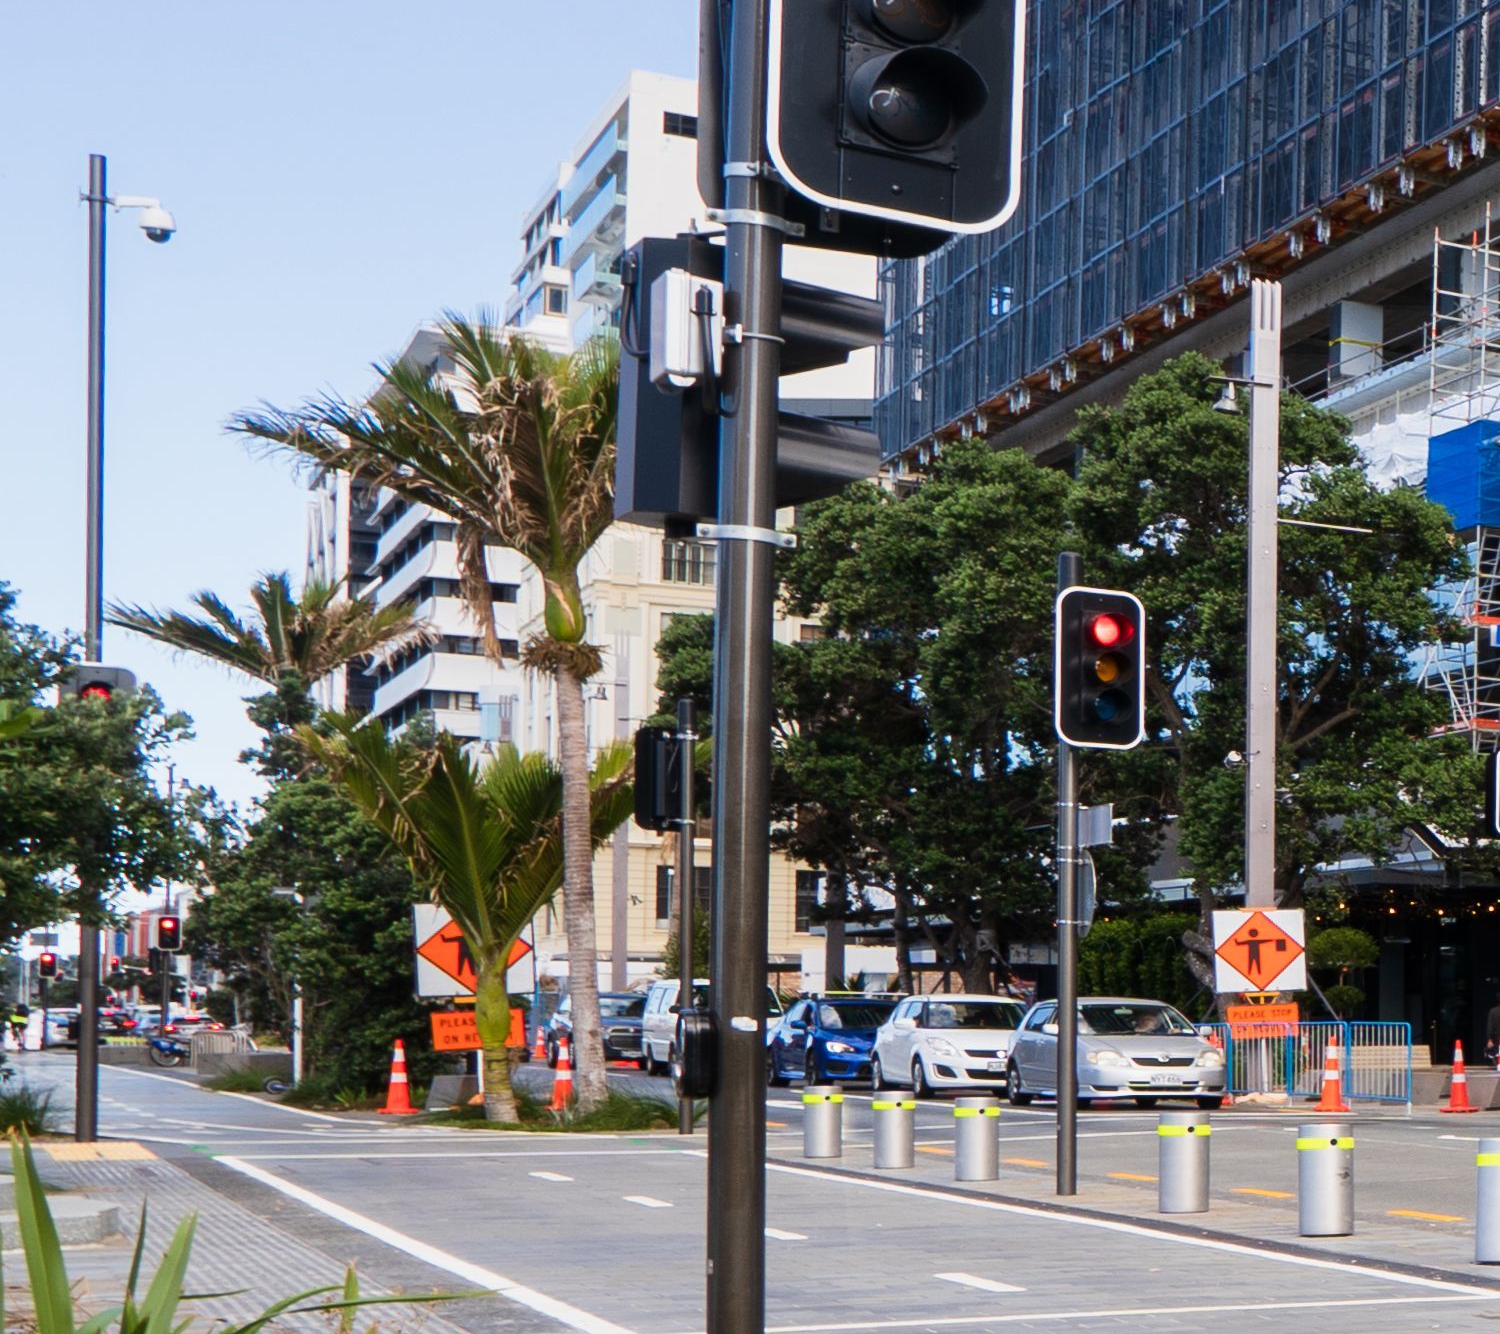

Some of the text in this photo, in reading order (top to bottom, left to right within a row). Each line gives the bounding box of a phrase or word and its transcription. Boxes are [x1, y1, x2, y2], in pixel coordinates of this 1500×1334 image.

[1233, 1011, 1265, 1019] PLEASE
[439, 1017, 477, 1028] PLEAS
[443, 1034, 459, 1044] ON
